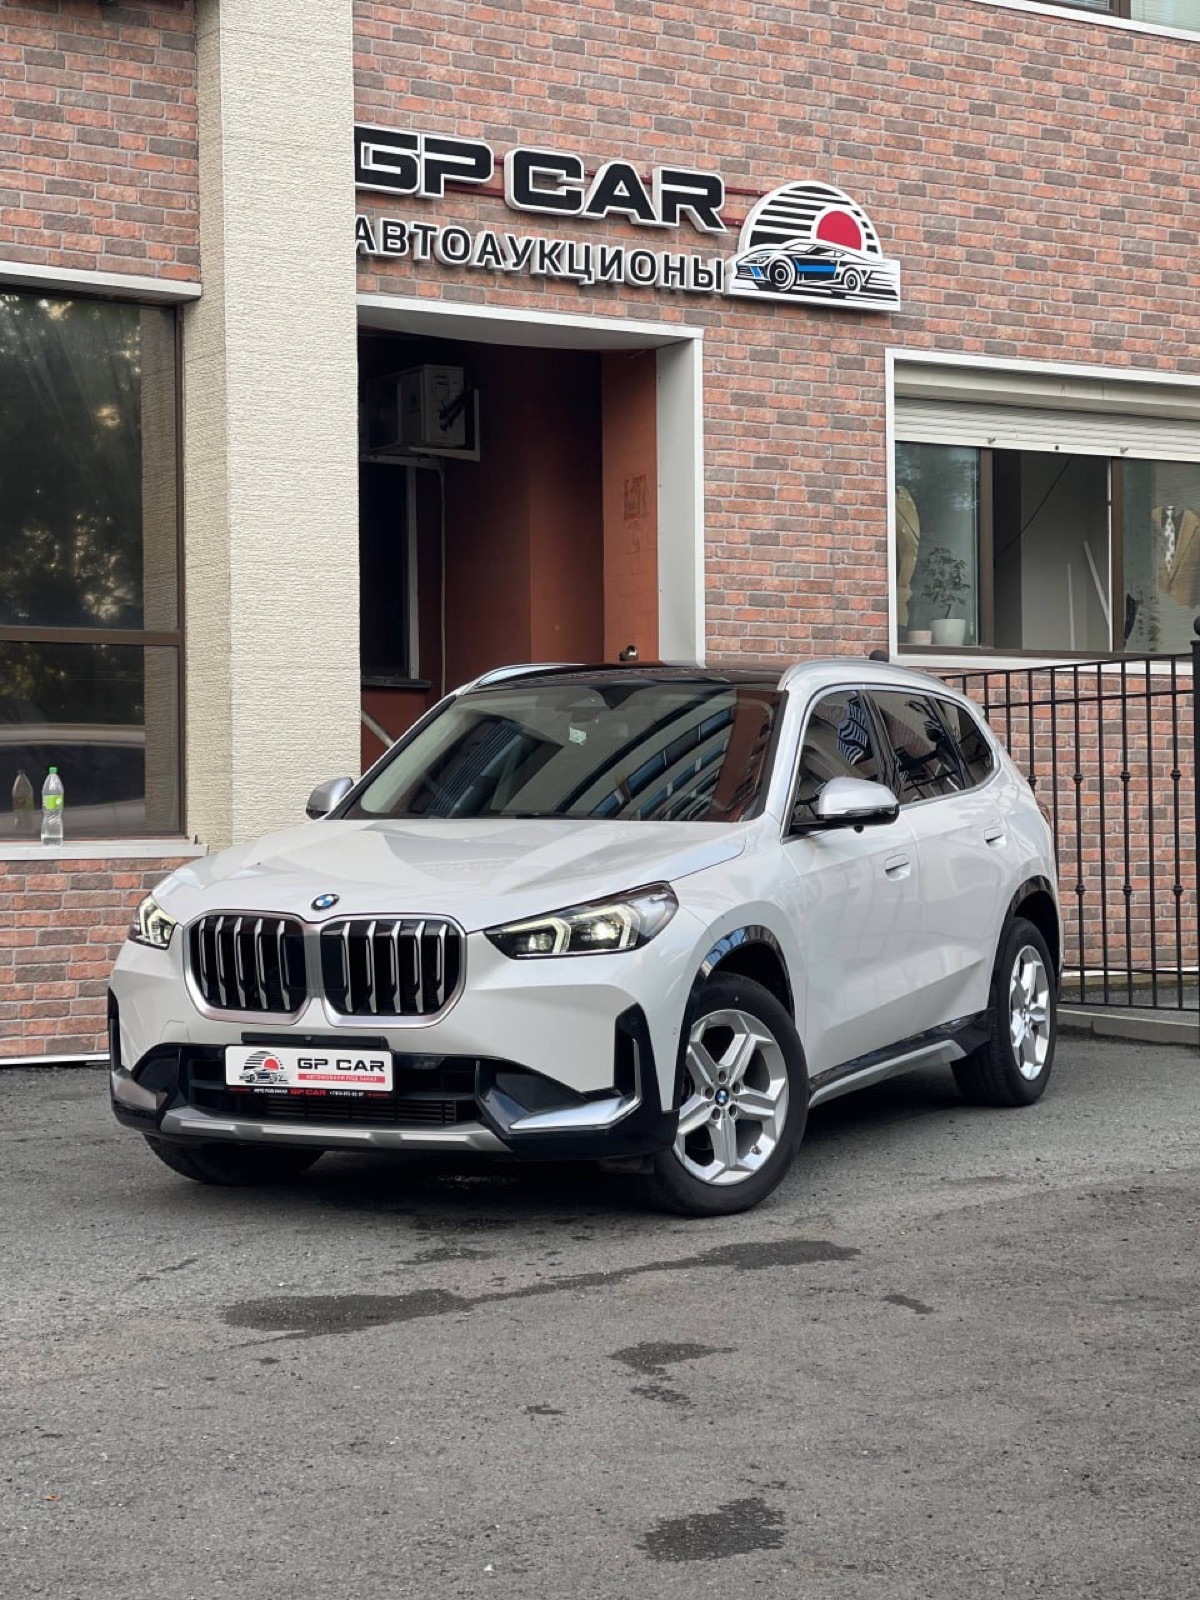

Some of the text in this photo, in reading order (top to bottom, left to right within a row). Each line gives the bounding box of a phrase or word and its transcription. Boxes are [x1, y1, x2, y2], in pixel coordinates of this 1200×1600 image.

[354, 125, 727, 233] GP CAR
[355, 214, 724, 294] АВТОАУКЦИОНЫ
[297, 1057, 385, 1072] GP CAR
